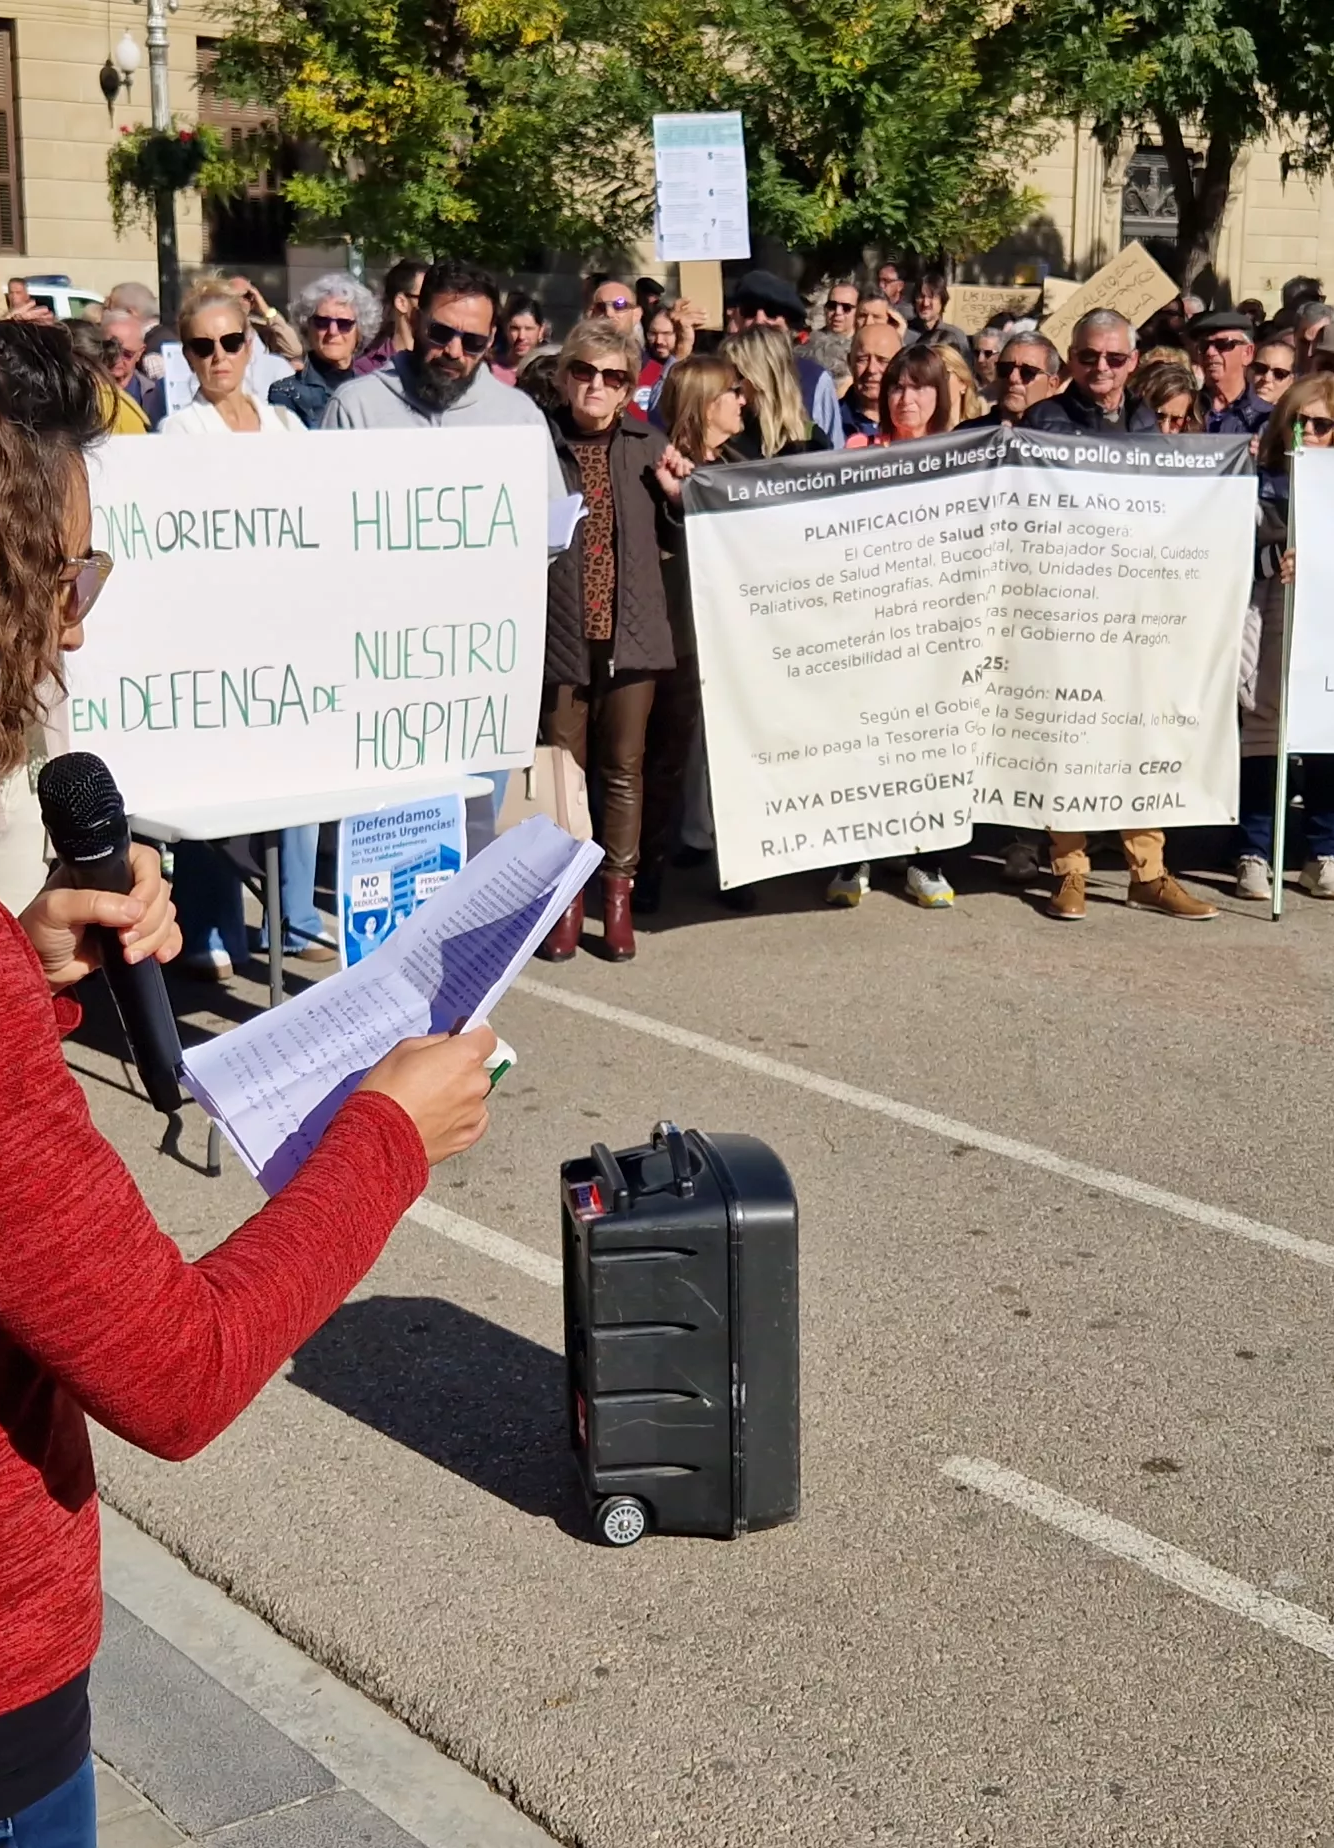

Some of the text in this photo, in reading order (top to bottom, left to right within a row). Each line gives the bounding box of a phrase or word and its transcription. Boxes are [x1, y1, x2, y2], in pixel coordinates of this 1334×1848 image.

[1106, 268, 1156, 310] STAMOS
[728, 483, 750, 503] La
[754, 473, 836, 499] Atención
[841, 460, 915, 485] Primaria
[918, 454, 941, 474] de
[945, 443, 1007, 469] Huesca
[1074, 444, 1121, 465] pollo
[1125, 447, 1151, 466] sin
[156, 505, 320, 553] ORIENTAL
[352, 483, 519, 551] HUESCA
[804, 504, 939, 542] PLANIFICACIÓN
[1027, 493, 1051, 508] EN
[1057, 494, 1079, 509] EL
[1085, 492, 1120, 510] AÑO
[1126, 499, 1166, 514] 2015:
[844, 547, 858, 562] El
[863, 539, 913, 559] Centro
[916, 534, 935, 550] de
[939, 523, 984, 545] Salud
[1023, 520, 1062, 535] Grial
[739, 577, 811, 598] Servicios
[815, 572, 835, 588] de
[839, 564, 880, 583] Salud
[1020, 540, 1105, 563] Trabajador
[1110, 543, 1156, 561] Social,
[1160, 546, 1209, 561] Cuidados
[749, 595, 828, 617] Paliativos,
[1038, 561, 1112, 577] Unidades
[873, 600, 918, 620] Habrá
[1001, 583, 1100, 600] poblacional.
[355, 618, 517, 681] NUESTRO
[772, 645, 791, 660] Se
[796, 629, 885, 658] acometerán
[889, 625, 911, 640] los
[915, 615, 982, 637] trabajos
[1013, 606, 1098, 624] necesarios
[1103, 613, 1136, 628] para
[1141, 614, 1187, 628] mejorar
[787, 664, 800, 679] la
[804, 646, 903, 676] accesibilidad
[907, 642, 920, 657] al
[1000, 625, 1015, 638] el
[1020, 625, 1095, 644] Gobierno
[1099, 630, 1117, 644] de
[1122, 631, 1171, 648] Aragón.
[72, 663, 347, 733] EN DEFENSA DE
[860, 708, 910, 726] Según
[915, 703, 929, 717] el
[985, 682, 1050, 701] Aragón:
[355, 693, 527, 771] HOSPITAL
[777, 748, 800, 762] me
[804, 745, 817, 758] lo
[823, 738, 862, 756] paga
[867, 734, 879, 748] la
[995, 705, 1009, 719] la
[1014, 708, 1096, 726] Seguridad
[1101, 711, 1146, 727] Social,
[1150, 713, 1160, 726] lo
[878, 754, 890, 766] si
[895, 752, 916, 764] no
[921, 746, 947, 761] me
[952, 743, 967, 756] lo
[991, 724, 1007, 738] lo
[765, 760, 1183, 816] ¡VAYA DESVERGÜENZ sanitaria CERO
[351, 807, 442, 836] ¡Defendamos
[351, 818, 456, 848] nuestras Urgencias!
[761, 833, 815, 859] R.I.P.
[822, 811, 945, 847] ATENCIÓN
[1013, 790, 1044, 811] EN
[1052, 795, 1123, 813] SANTO
[1131, 792, 1186, 812] GRIAL
[360, 876, 380, 889] NO
[370, 889, 379, 897] LA
